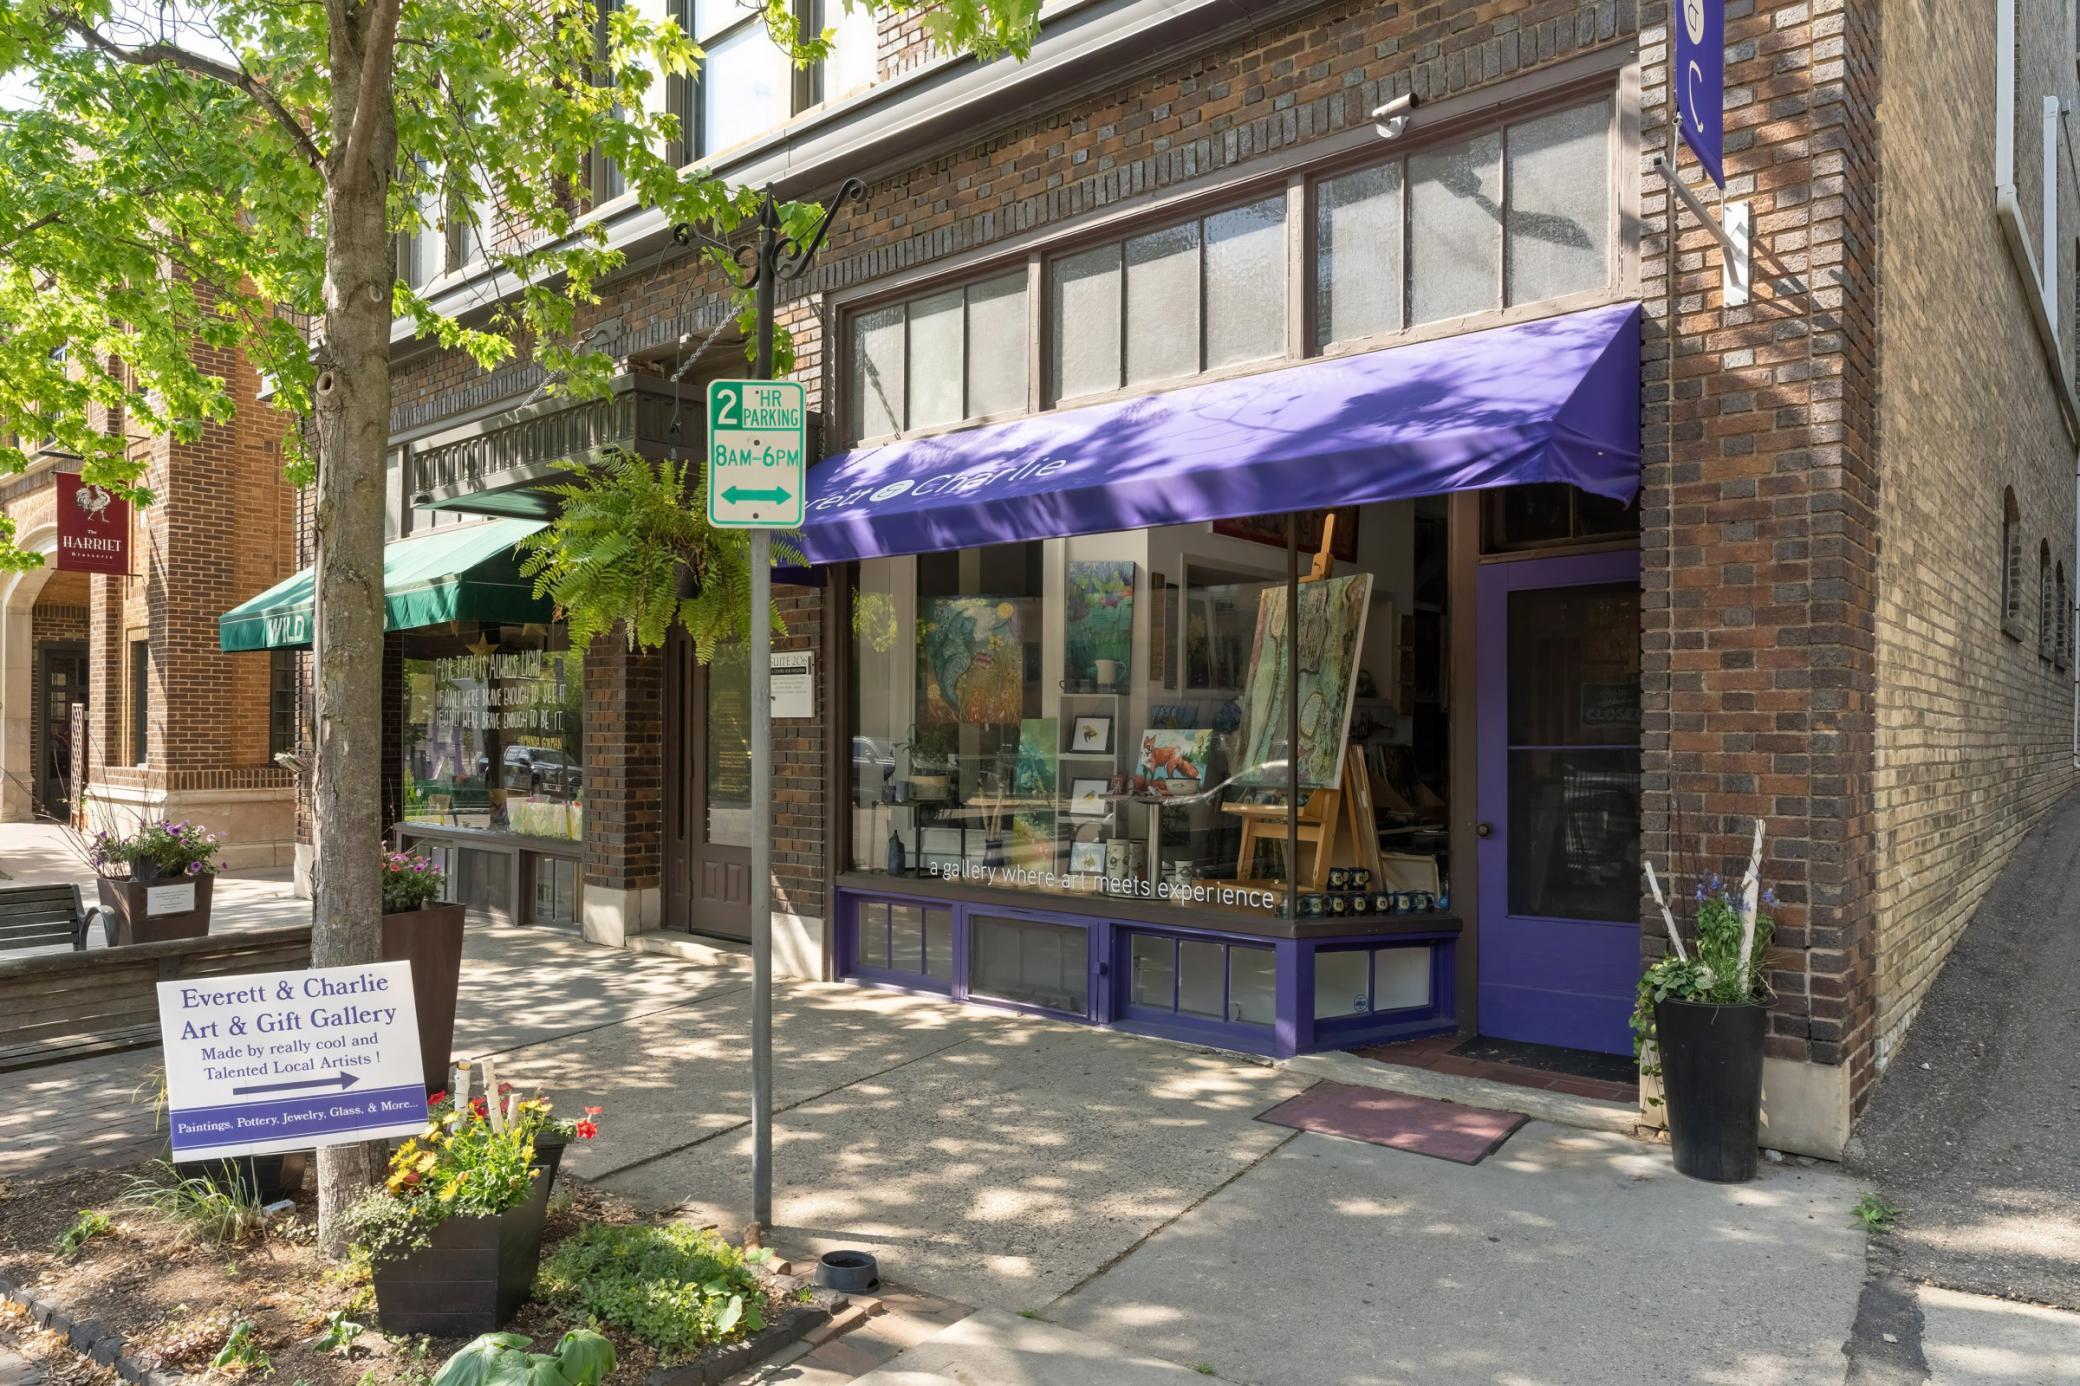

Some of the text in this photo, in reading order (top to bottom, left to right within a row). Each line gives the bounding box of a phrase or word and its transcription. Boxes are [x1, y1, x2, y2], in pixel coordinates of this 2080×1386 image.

[717, 388, 782, 425] 2 HR
[743, 408, 799, 427] PARKING
[715, 444, 799, 467] 8AM-6PM
[805, 487, 875, 510] rett
[911, 457, 1067, 497] Charlie
[63, 535, 122, 552] HARRIET
[266, 615, 305, 646] WILD
[930, 859, 1274, 909] a gallery where art meets experience
[180, 973, 390, 1009] Everett & Charlie
[180, 1005, 397, 1041] Art & Gift Gallery
[201, 1031, 379, 1061] Made by really cool and
[203, 1062, 269, 1080] Talented
[273, 1058, 315, 1074] Local
[282, 1110, 327, 1125] Jewelry,
[367, 1102, 377, 1113] &
